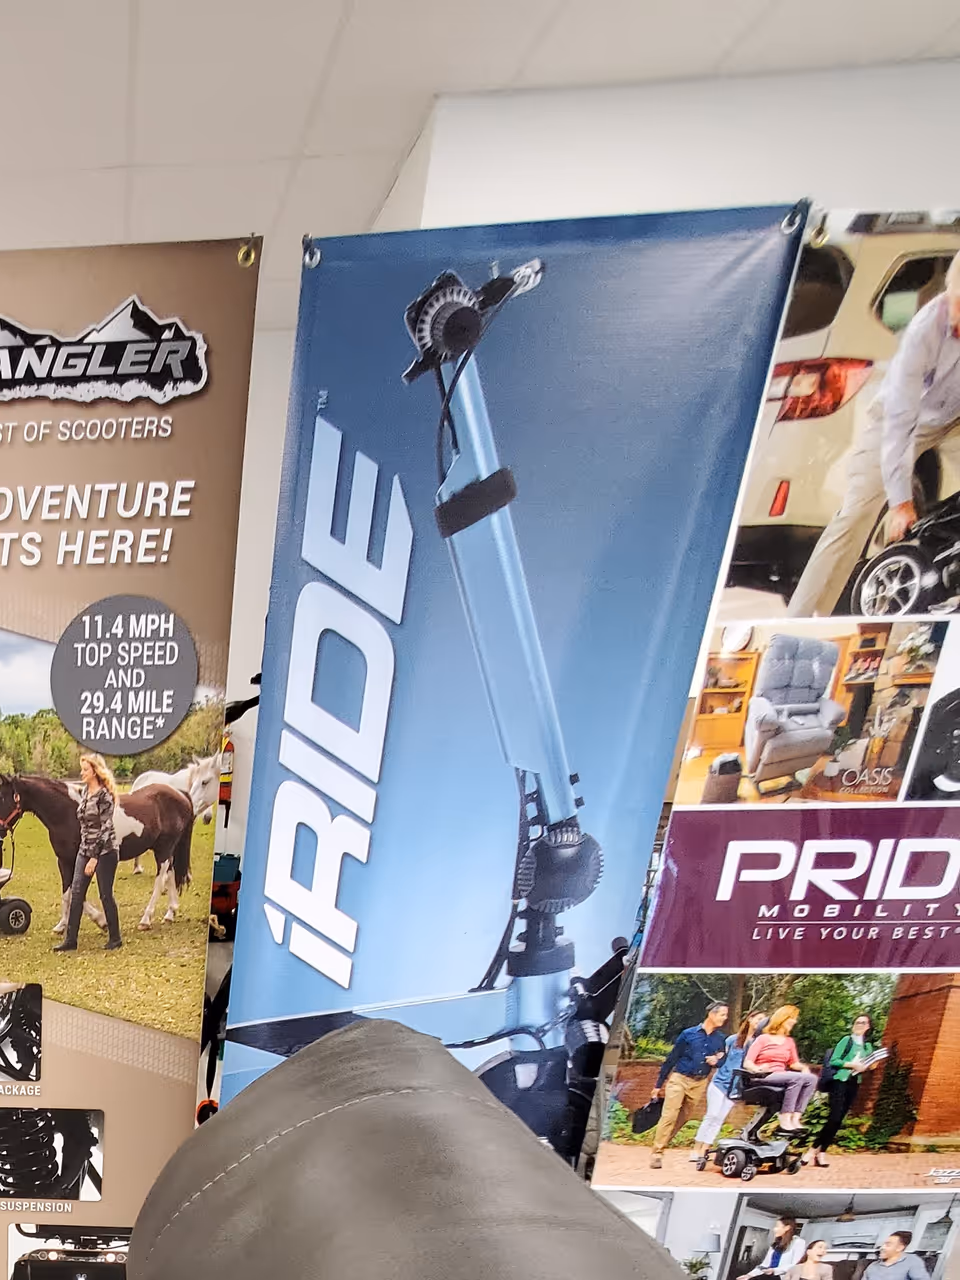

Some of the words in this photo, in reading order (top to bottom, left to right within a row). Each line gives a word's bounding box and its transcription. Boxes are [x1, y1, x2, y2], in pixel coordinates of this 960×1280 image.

[23, 420, 51, 442] OF
[57, 416, 173, 441] SCOOTERS
[56, 528, 174, 566] HERE!
[82, 614, 124, 639] 11.4
[129, 613, 175, 638] MPH
[74, 642, 112, 666] TOP
[117, 641, 179, 666] SPEED
[104, 669, 145, 689] AND
[80, 691, 123, 715] 29.4
[128, 690, 174, 714] MILE
[842, 767, 893, 786] OASIS
[752, 927, 805, 940] LIVE
[820, 926, 879, 940] YOUR
[892, 926, 952, 940] BEST
[0, 1201, 72, 1213] SUSPENSION
